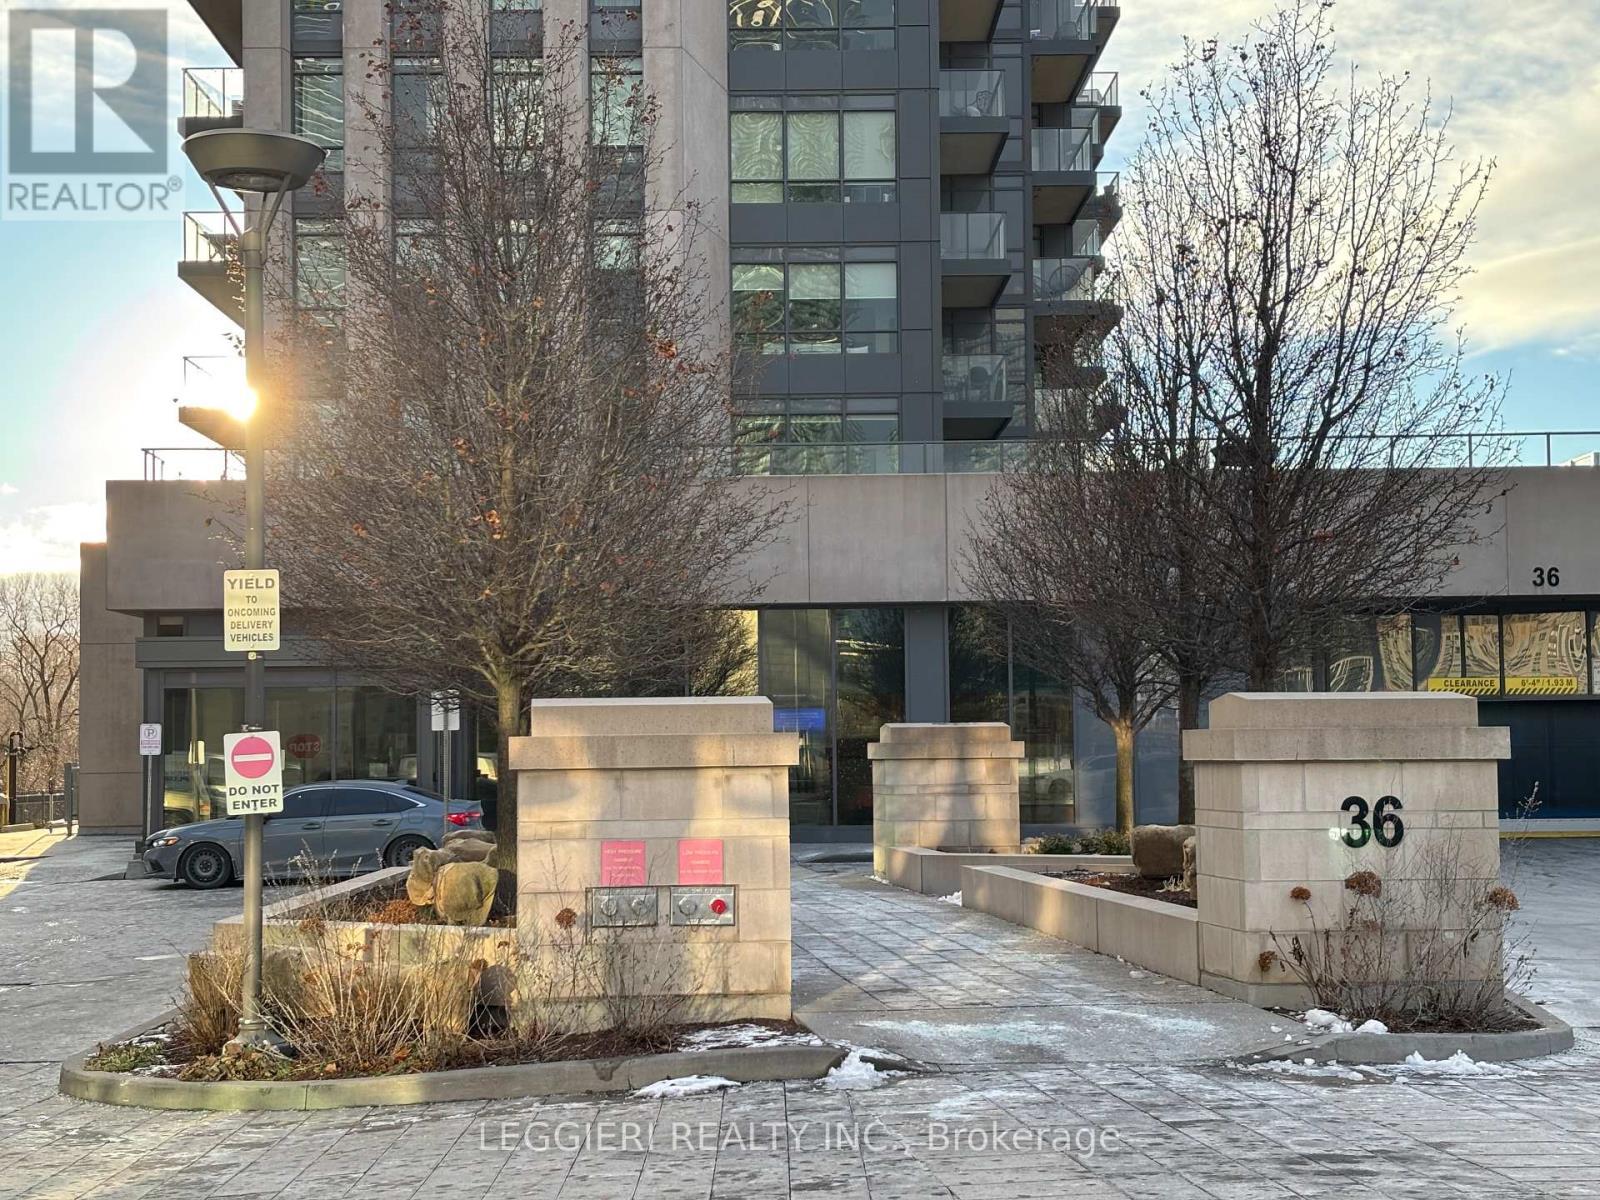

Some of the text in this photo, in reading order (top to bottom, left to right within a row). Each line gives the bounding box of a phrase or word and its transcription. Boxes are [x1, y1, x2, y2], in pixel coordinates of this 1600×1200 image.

[1532, 567, 1560, 587] 36
[227, 578, 275, 589] YIELD
[245, 595, 258, 604] TO
[227, 608, 276, 617] ONCOMING
[230, 620, 273, 629] DELIVERY
[230, 633, 274, 642] VEHICLES
[1443, 679, 1495, 687] CLEARANCE
[1547, 679, 1564, 687] 1.93
[1566, 679, 1573, 687] M
[229, 784, 280, 796] DO NOT
[232, 798, 278, 810] ENTER
[1340, 795, 1404, 848] 36
